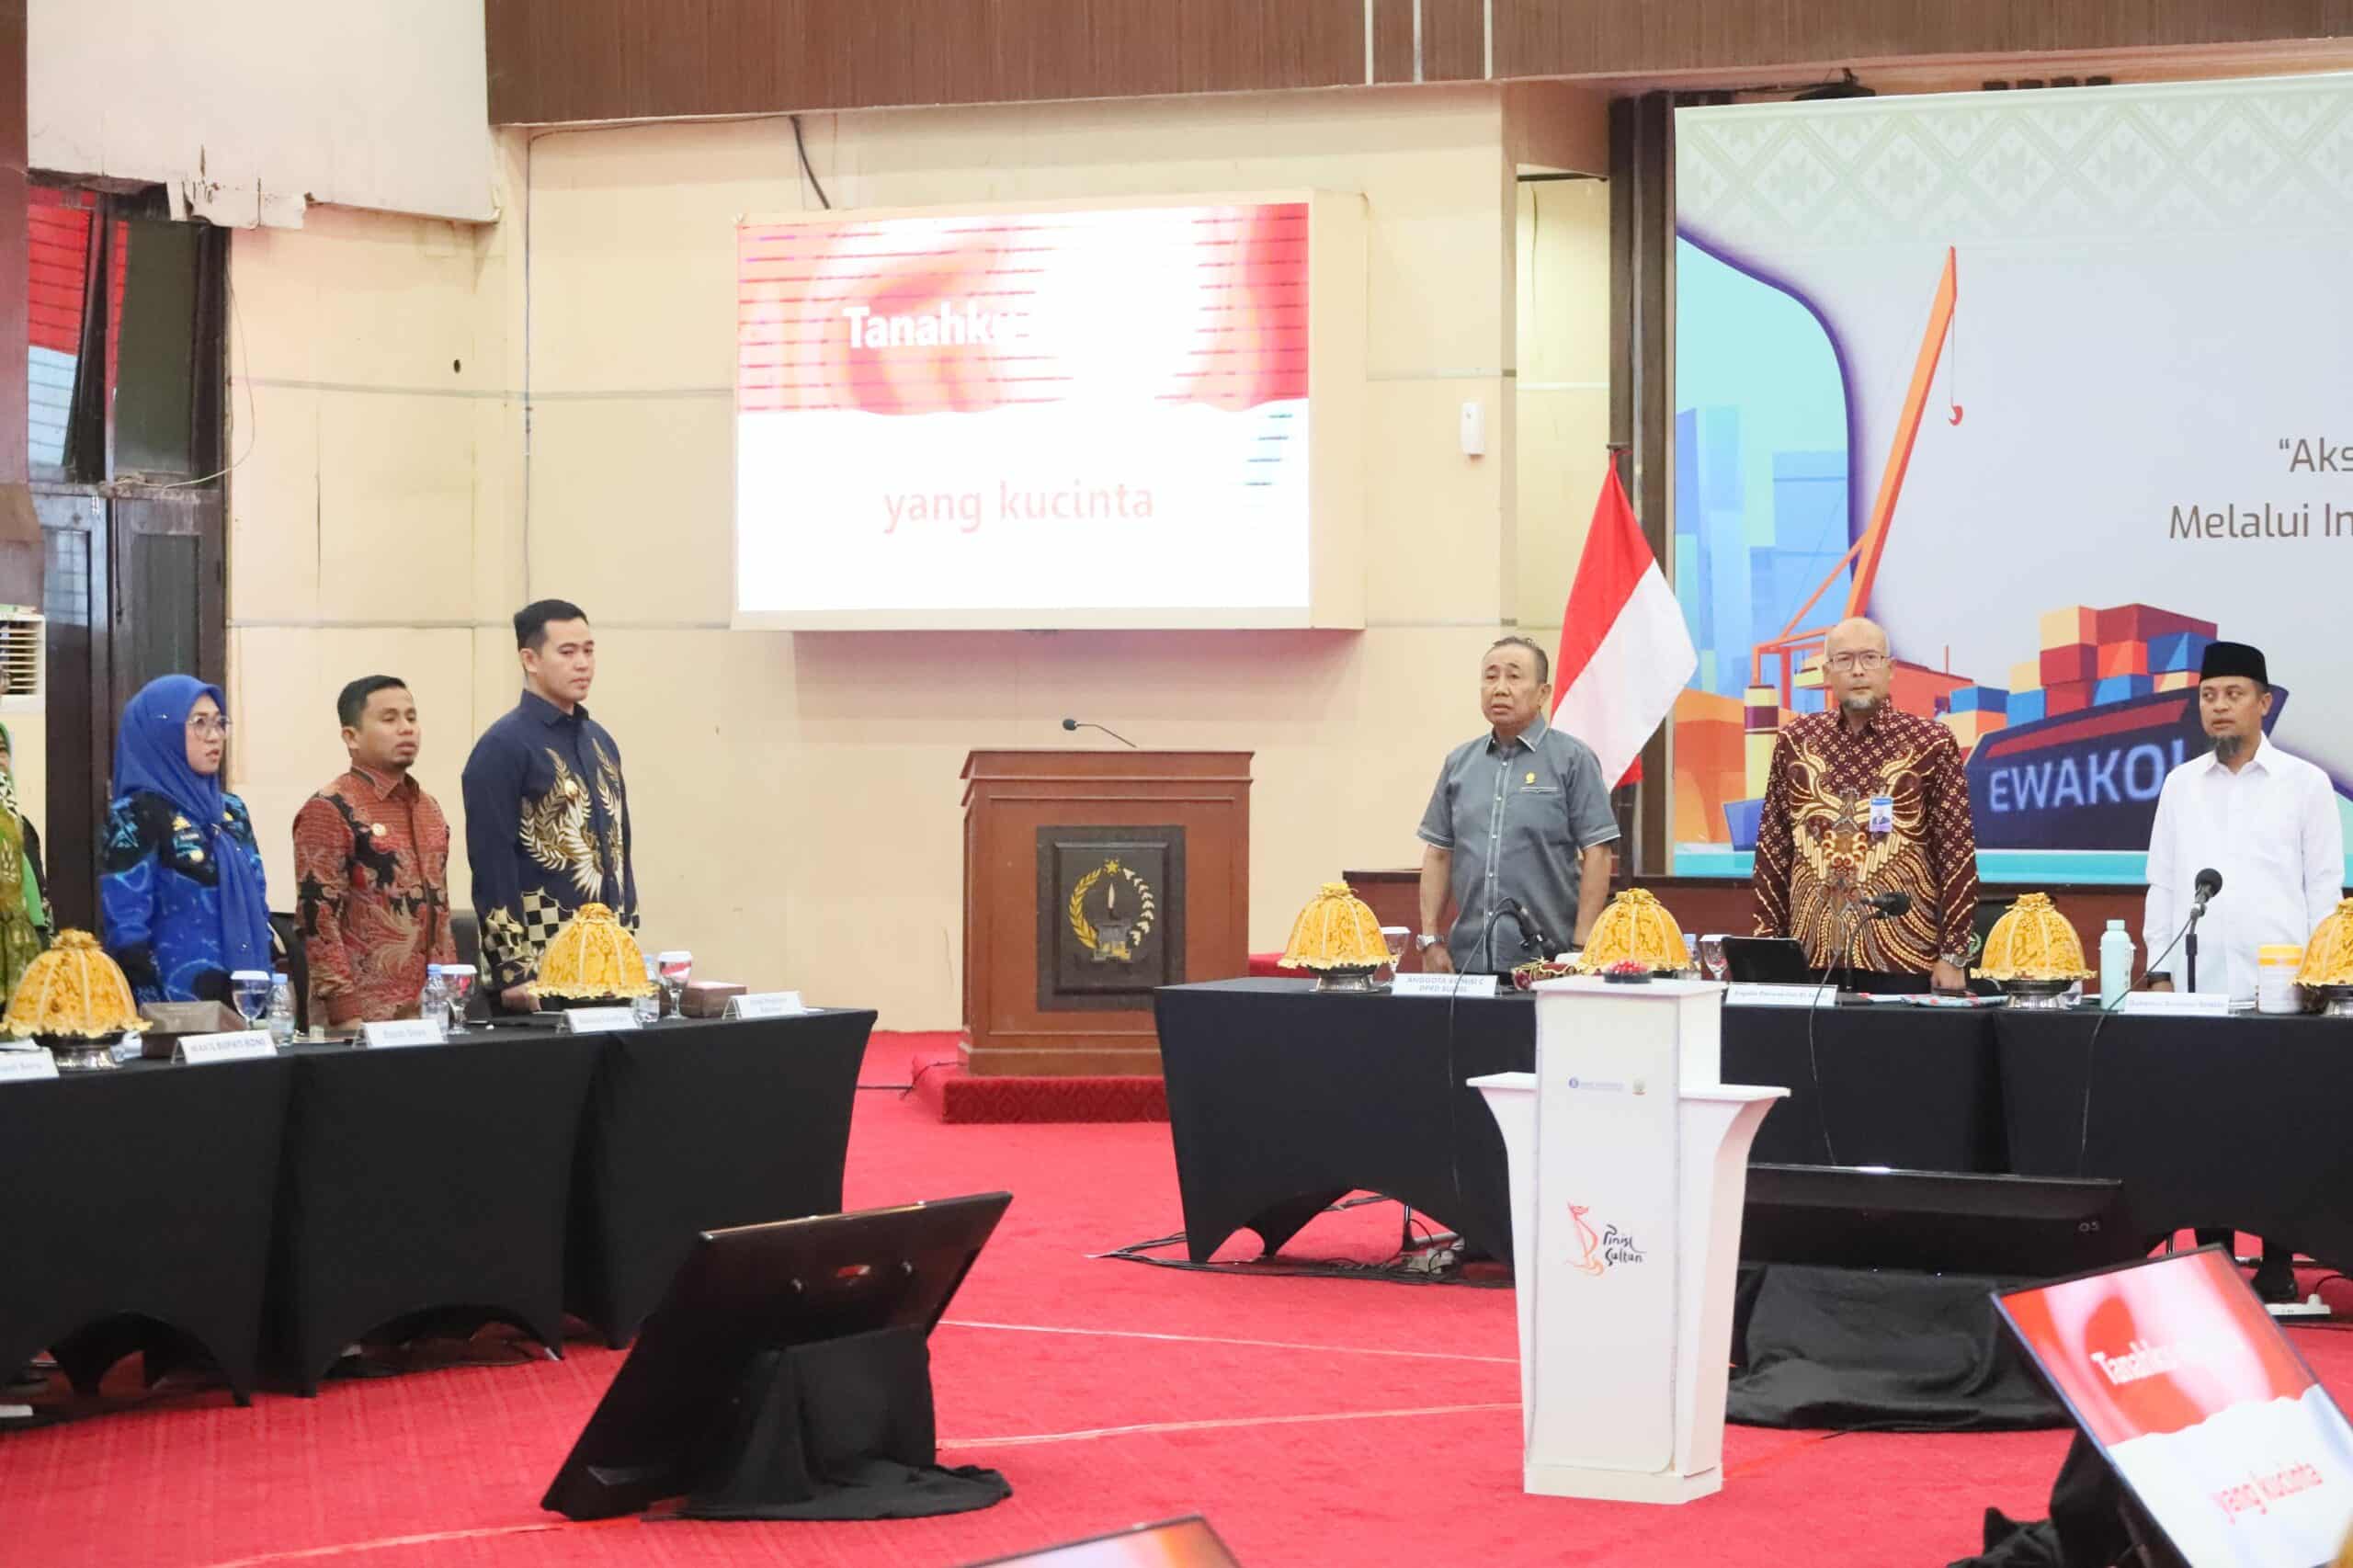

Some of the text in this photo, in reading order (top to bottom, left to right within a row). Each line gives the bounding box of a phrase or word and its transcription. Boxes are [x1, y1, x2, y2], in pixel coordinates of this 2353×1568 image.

[882, 478, 1154, 534] yang kucinta
[2169, 503, 2353, 540] Melalui In
[1605, 1247, 1643, 1267] Sultan
